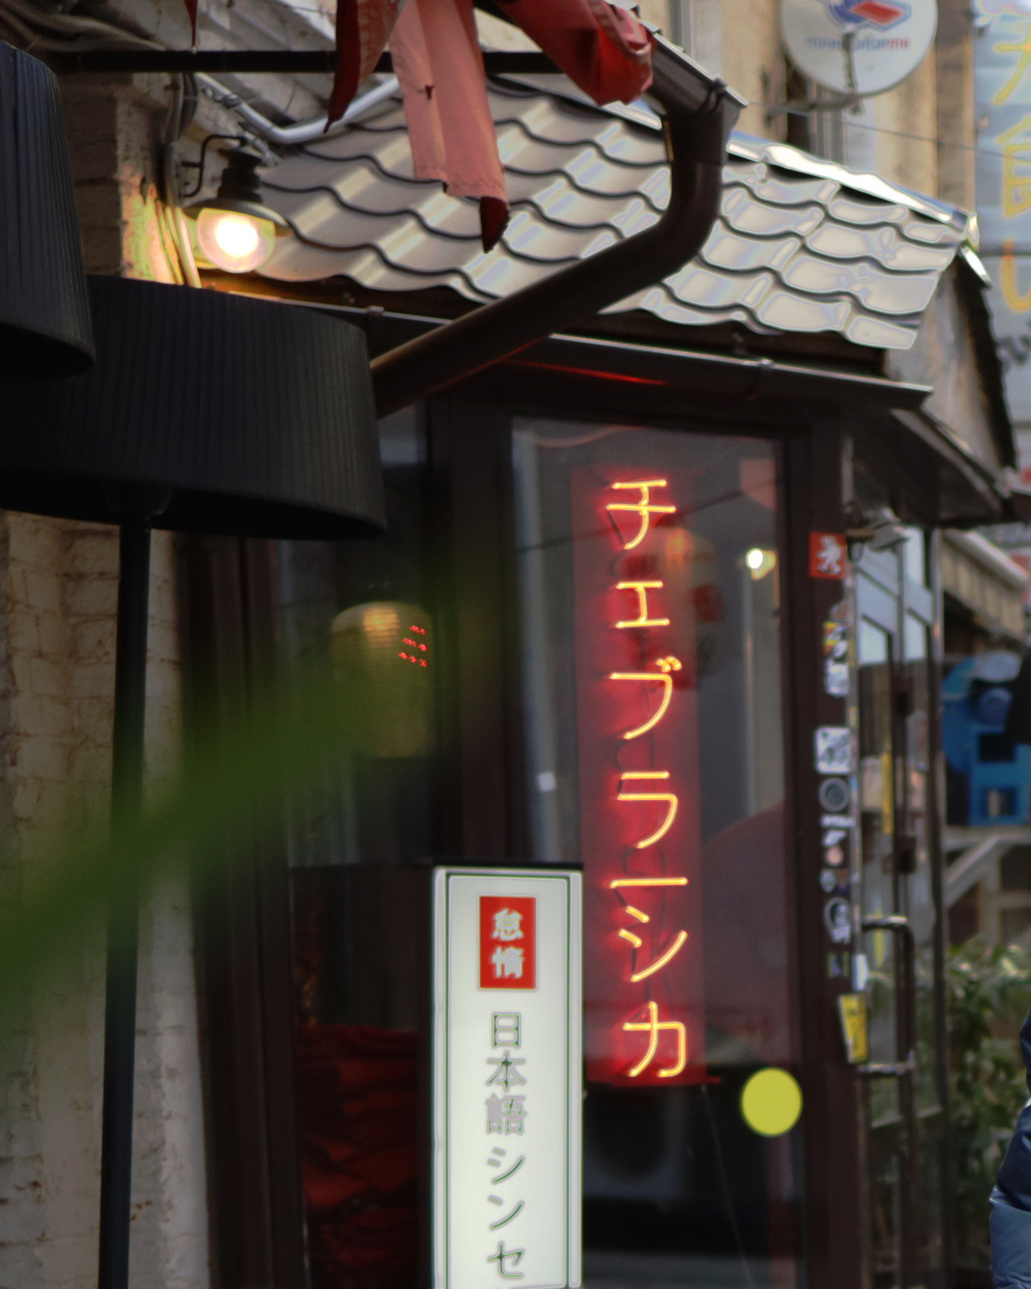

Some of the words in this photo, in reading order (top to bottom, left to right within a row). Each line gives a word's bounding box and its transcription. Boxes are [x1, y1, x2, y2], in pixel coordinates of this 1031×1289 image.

[606, 478, 688, 1078] チェブラーシカ
